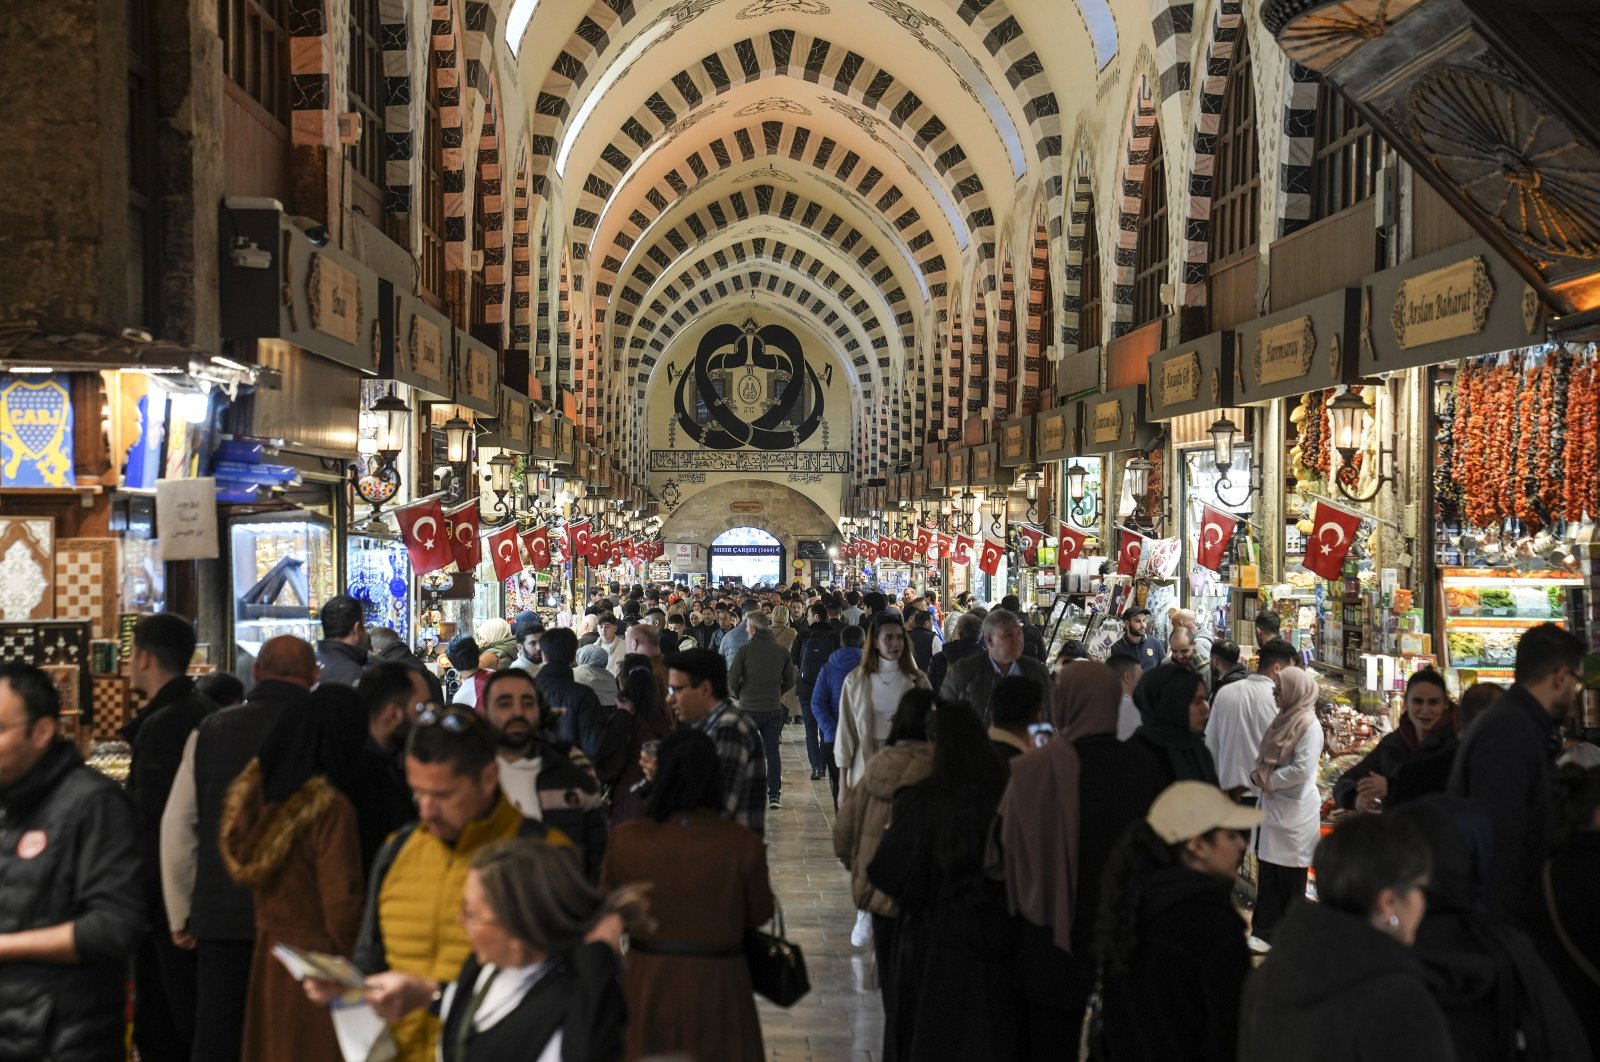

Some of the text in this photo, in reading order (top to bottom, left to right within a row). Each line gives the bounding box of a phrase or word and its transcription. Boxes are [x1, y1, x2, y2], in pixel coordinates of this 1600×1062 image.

[1406, 286, 1472, 326] Arslan Baharat
[10, 409, 62, 425] CABJ
